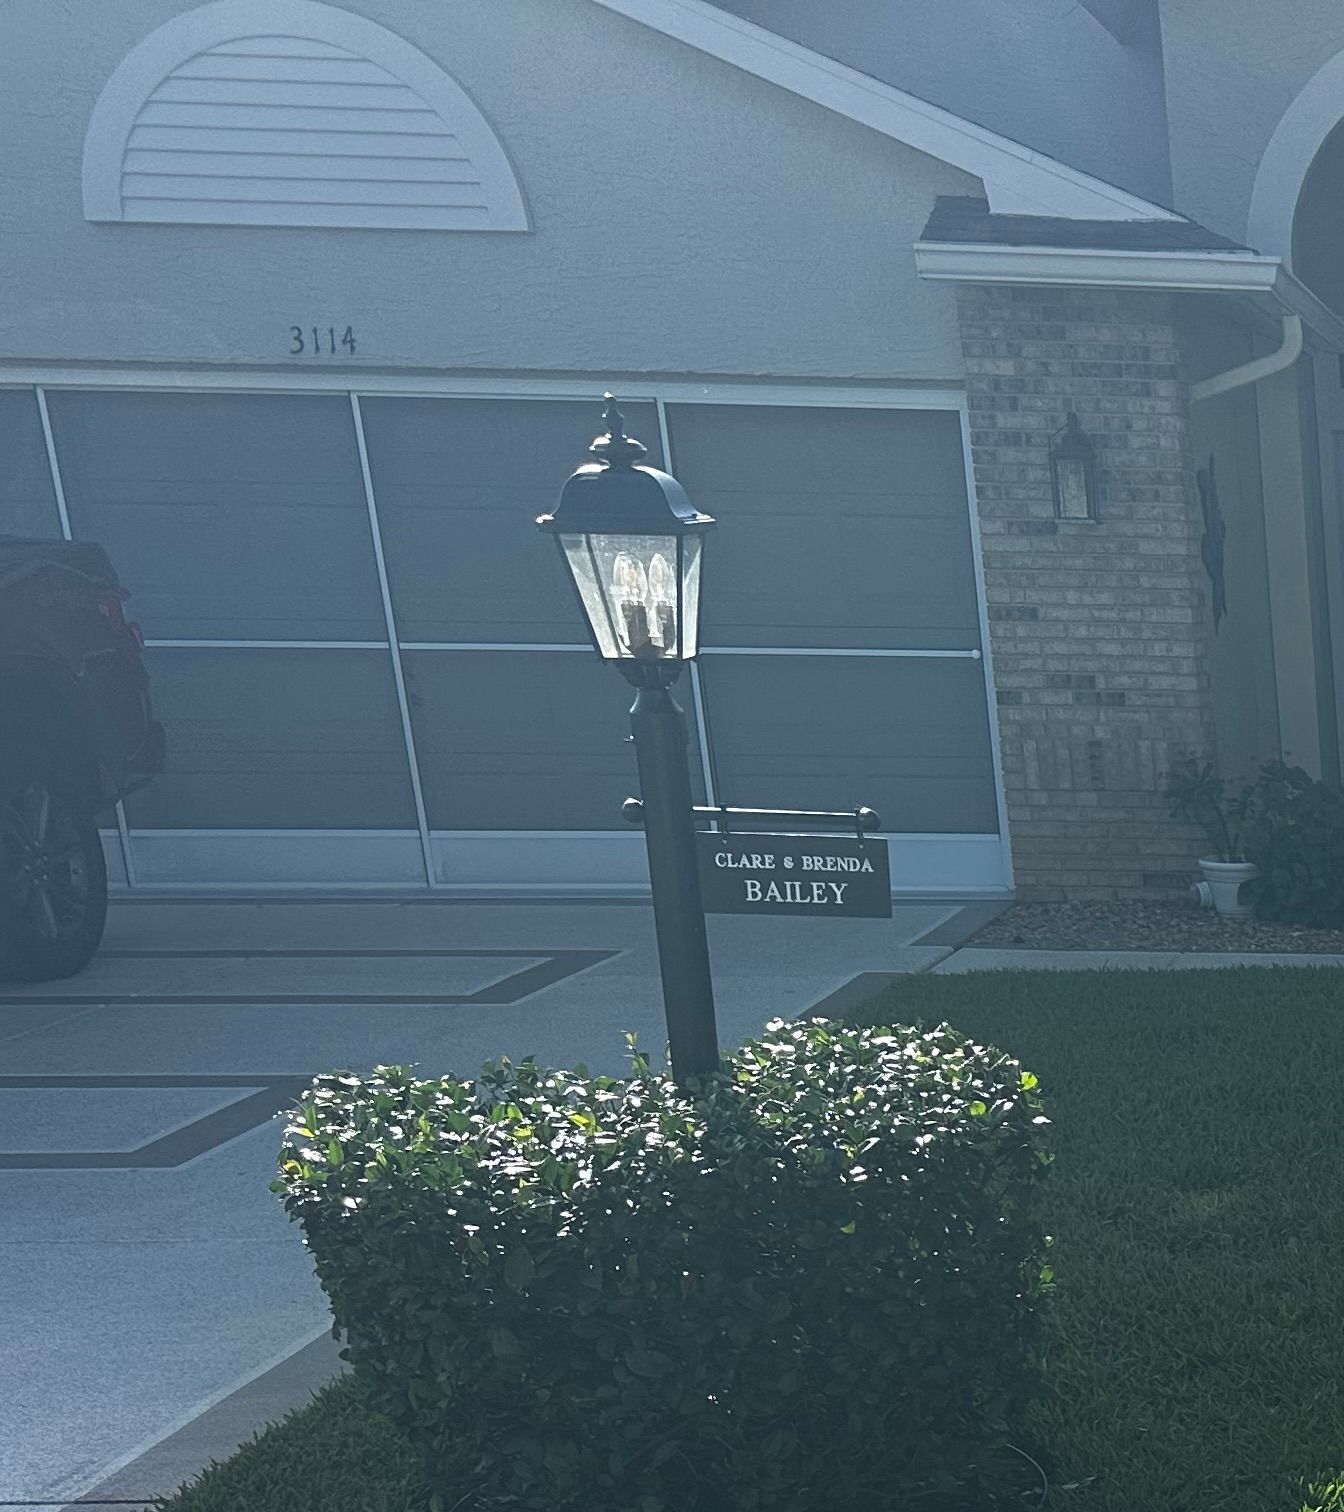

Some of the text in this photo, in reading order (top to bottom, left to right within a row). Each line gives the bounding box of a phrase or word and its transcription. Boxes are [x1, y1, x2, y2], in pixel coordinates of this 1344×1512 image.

[289, 325, 356, 355] 3114
[714, 852, 875, 873] CLARE & BRENDA
[743, 879, 849, 905] BAILEY
